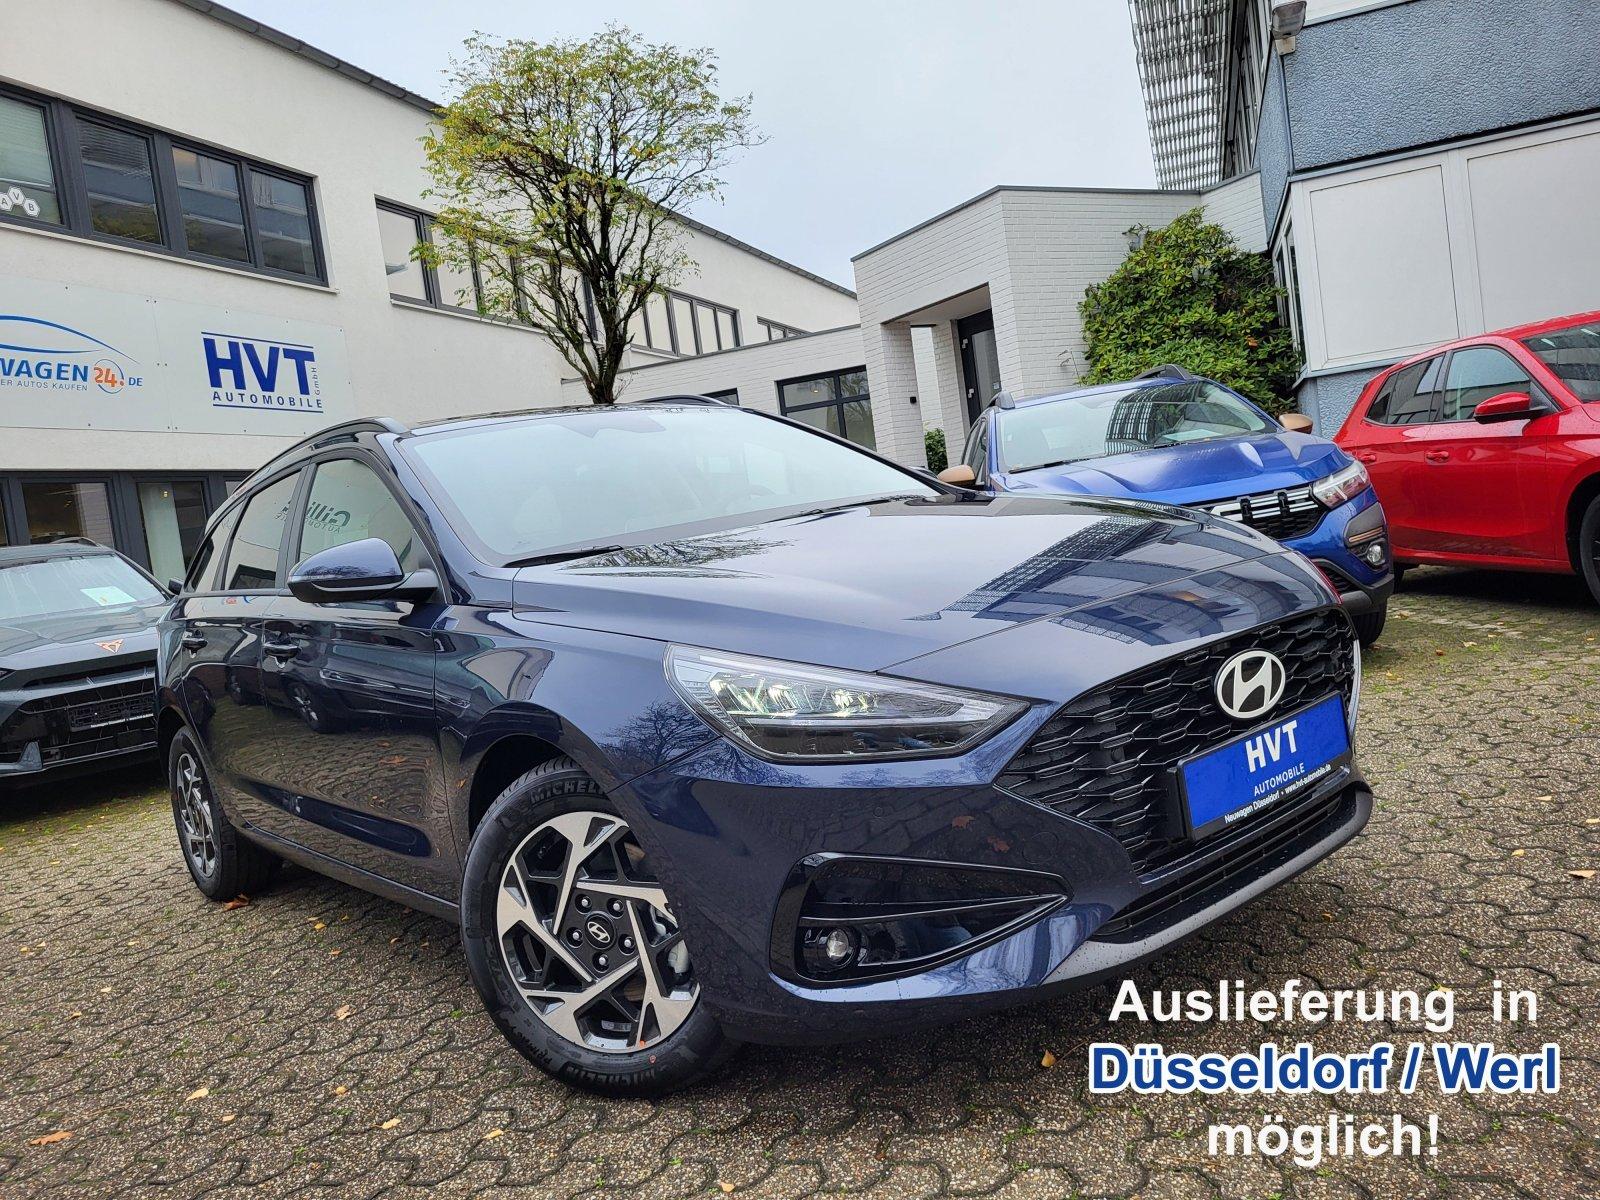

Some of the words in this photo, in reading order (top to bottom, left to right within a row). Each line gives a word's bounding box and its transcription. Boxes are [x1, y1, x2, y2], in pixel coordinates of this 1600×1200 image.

[203, 337, 315, 396] HVT
[16, 380, 48, 389] AUTOS
[52, 382, 88, 391] KAUFEN
[311, 367, 321, 396] GmbH
[212, 391, 323, 409] AUTOMOBILE
[1245, 720, 1298, 773] HVT
[530, 779, 606, 803] MICHEL
[1254, 762, 1306, 797] AUTOMOBILE
[1224, 803, 1254, 824] Neuwagen
